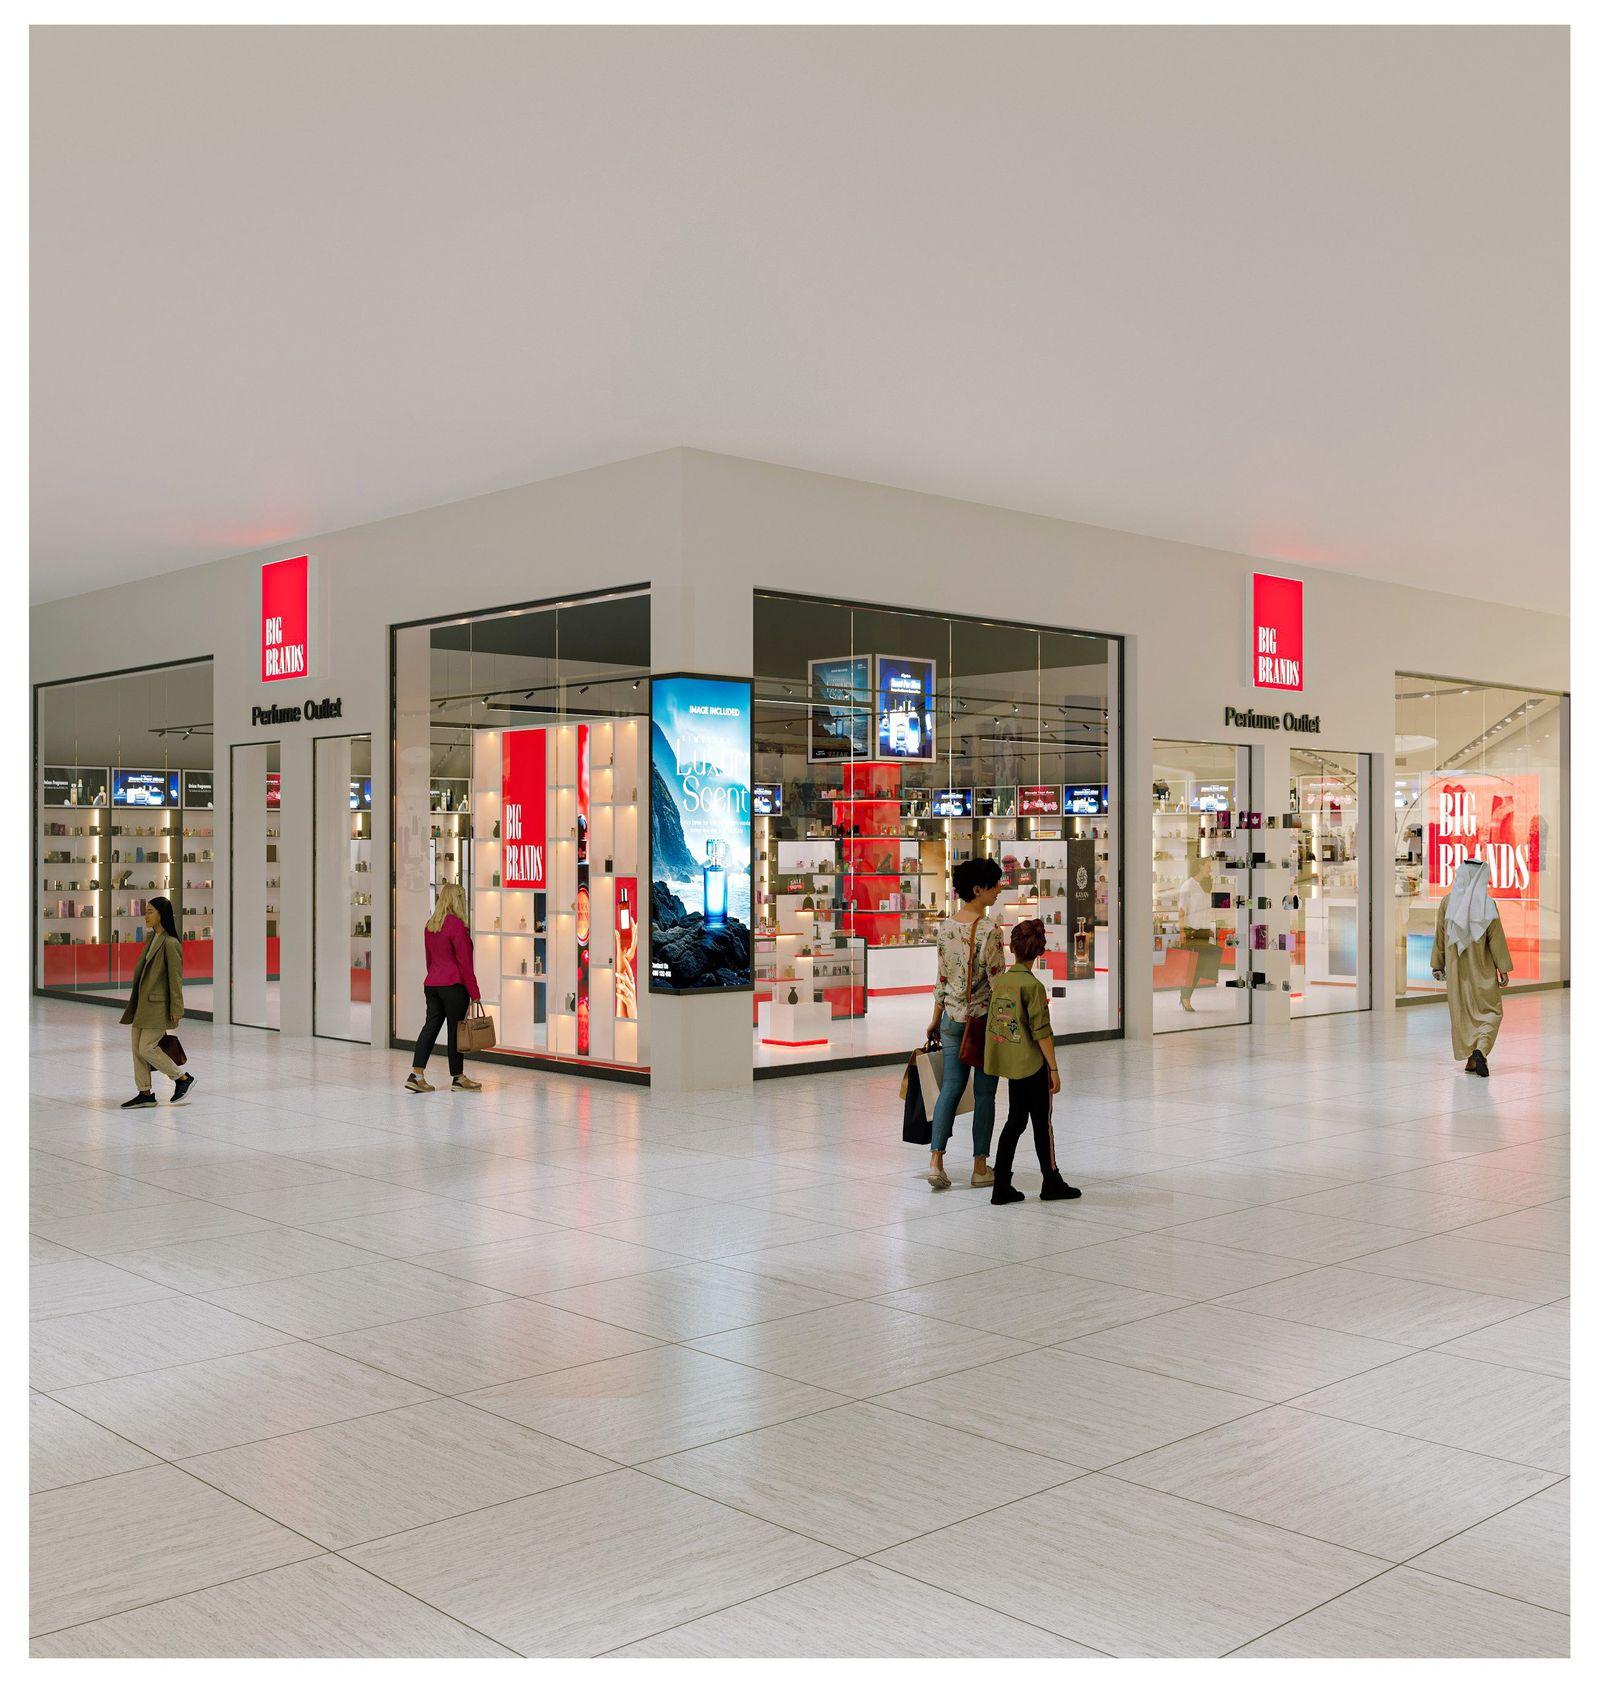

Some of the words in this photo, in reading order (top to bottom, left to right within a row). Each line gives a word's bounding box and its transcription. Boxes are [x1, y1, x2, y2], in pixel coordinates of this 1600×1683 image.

[265, 616, 283, 646] BIG
[1258, 626, 1277, 655] BIG
[265, 643, 304, 677] BRANDS
[1258, 655, 1300, 687] BRANDS
[252, 704, 302, 726] Perfume
[303, 697, 343, 721] Outlet
[689, 705, 709, 715] IMAGE
[709, 706, 740, 717] INCLUDED
[1225, 706, 1281, 730] Perfume
[1283, 712, 1322, 734] Outlet
[682, 775, 748, 813] Scent
[506, 804, 522, 840] BIG
[1438, 791, 1477, 837] BIG
[506, 845, 543, 881] BRANDS
